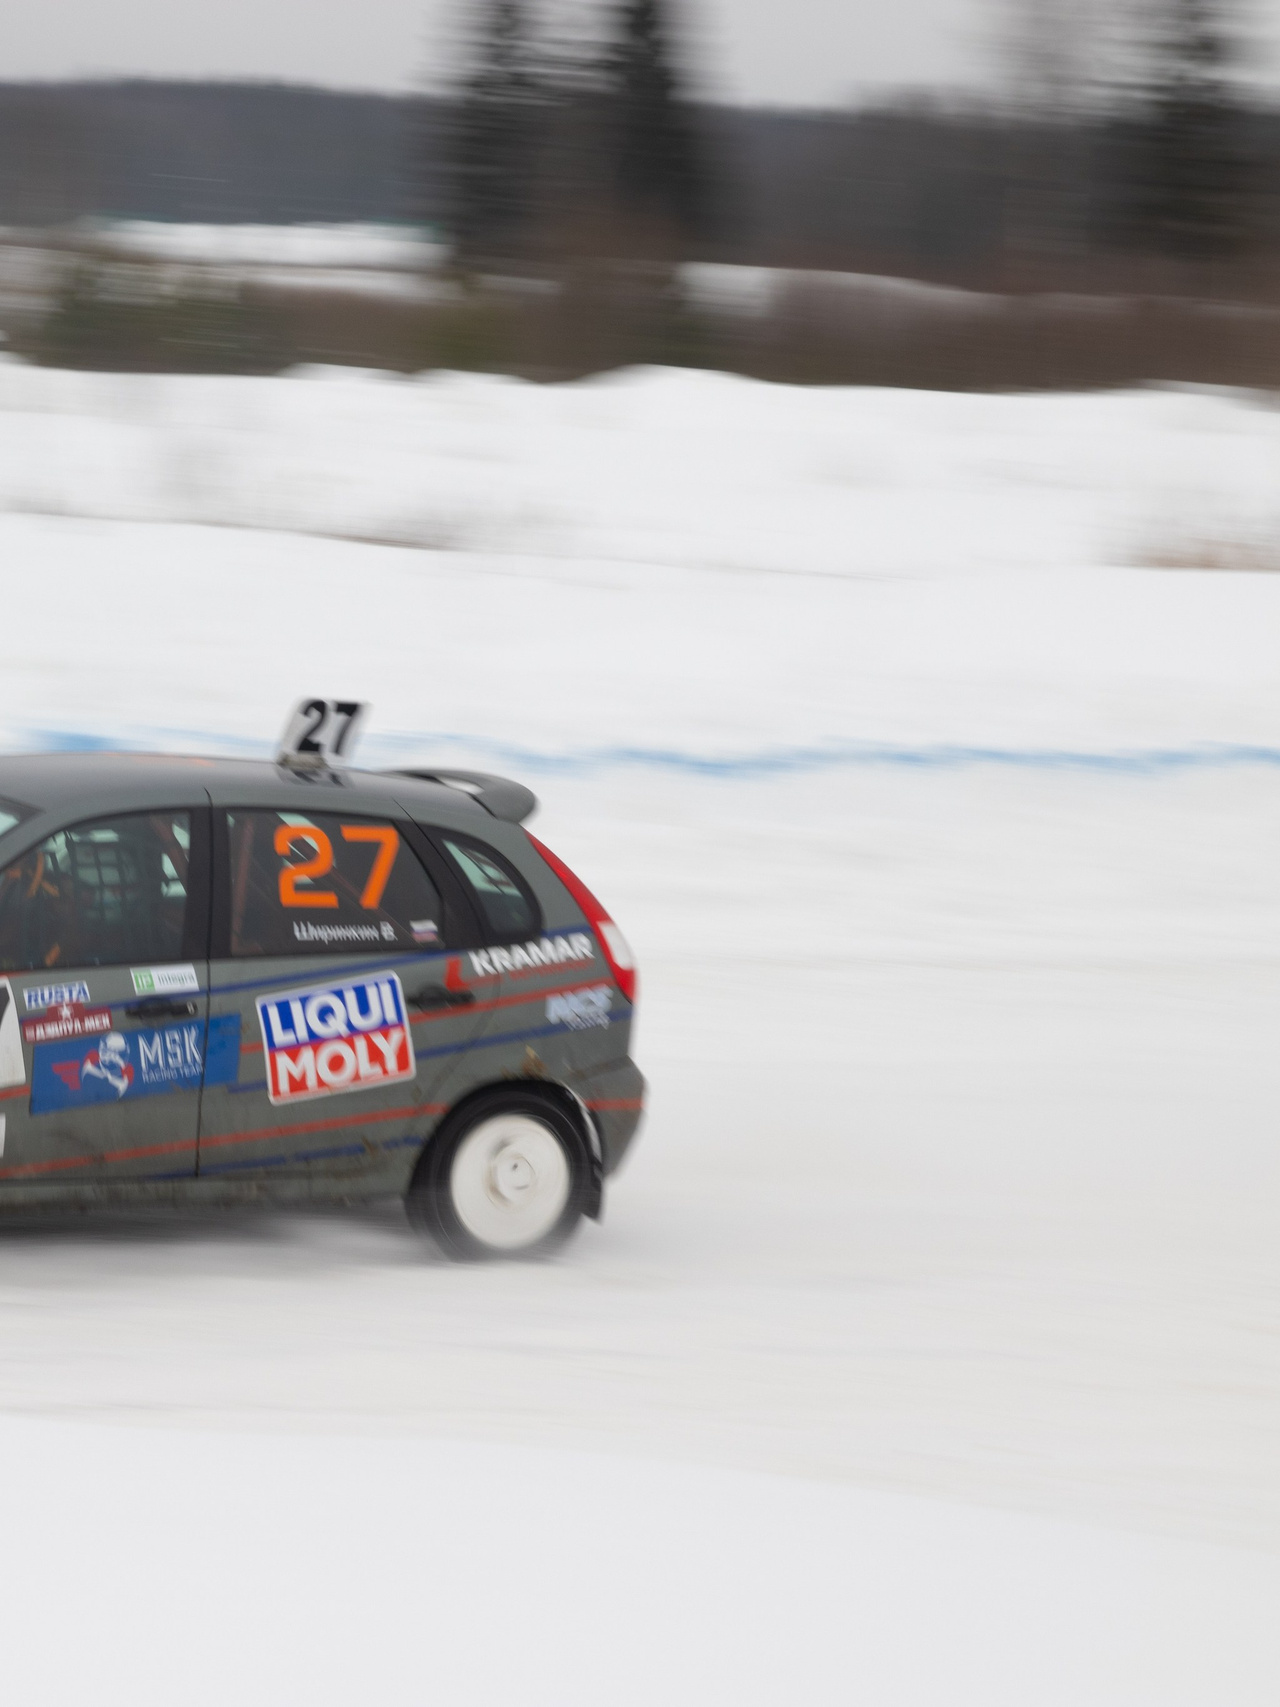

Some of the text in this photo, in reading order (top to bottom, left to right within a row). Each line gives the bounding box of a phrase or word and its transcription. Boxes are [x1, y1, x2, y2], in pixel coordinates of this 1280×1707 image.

[295, 698, 363, 756] 27
[273, 825, 400, 909] 27
[468, 932, 595, 977] KRAMAR
[267, 979, 398, 1047] LIQUI
[138, 1026, 202, 1072] MSK
[274, 1028, 405, 1095] MOLY
